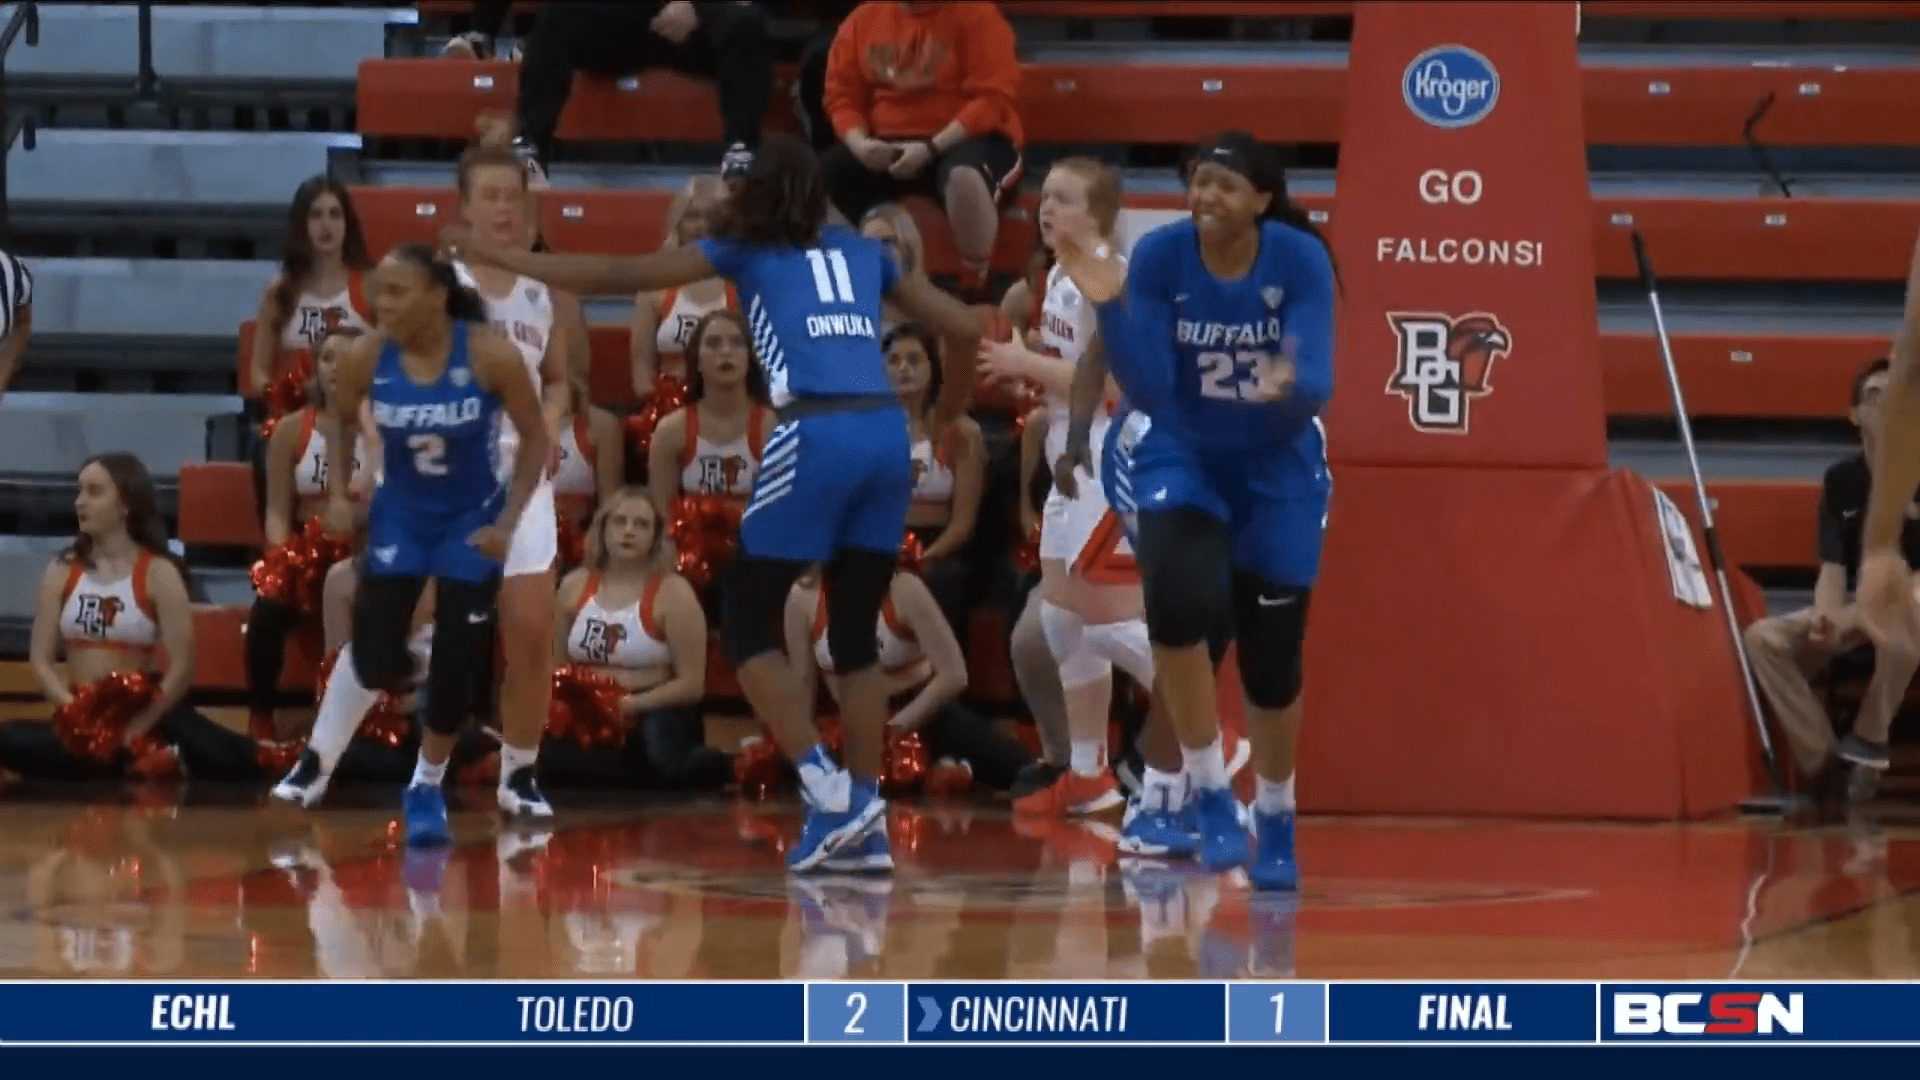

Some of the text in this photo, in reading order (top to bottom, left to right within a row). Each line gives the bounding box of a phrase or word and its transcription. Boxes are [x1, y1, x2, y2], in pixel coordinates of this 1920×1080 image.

[1416, 59, 1490, 115] Kroger
[1419, 168, 1483, 204] GO
[1376, 237, 1543, 266] FALCONS!
[805, 248, 855, 304] 11
[806, 313, 876, 339] ONWUKA
[1176, 318, 1280, 347] BUFFALO
[1197, 351, 1269, 401] 23
[1399, 320, 1460, 424] BG
[373, 397, 482, 428] BUFFALO
[407, 433, 449, 476] 2
